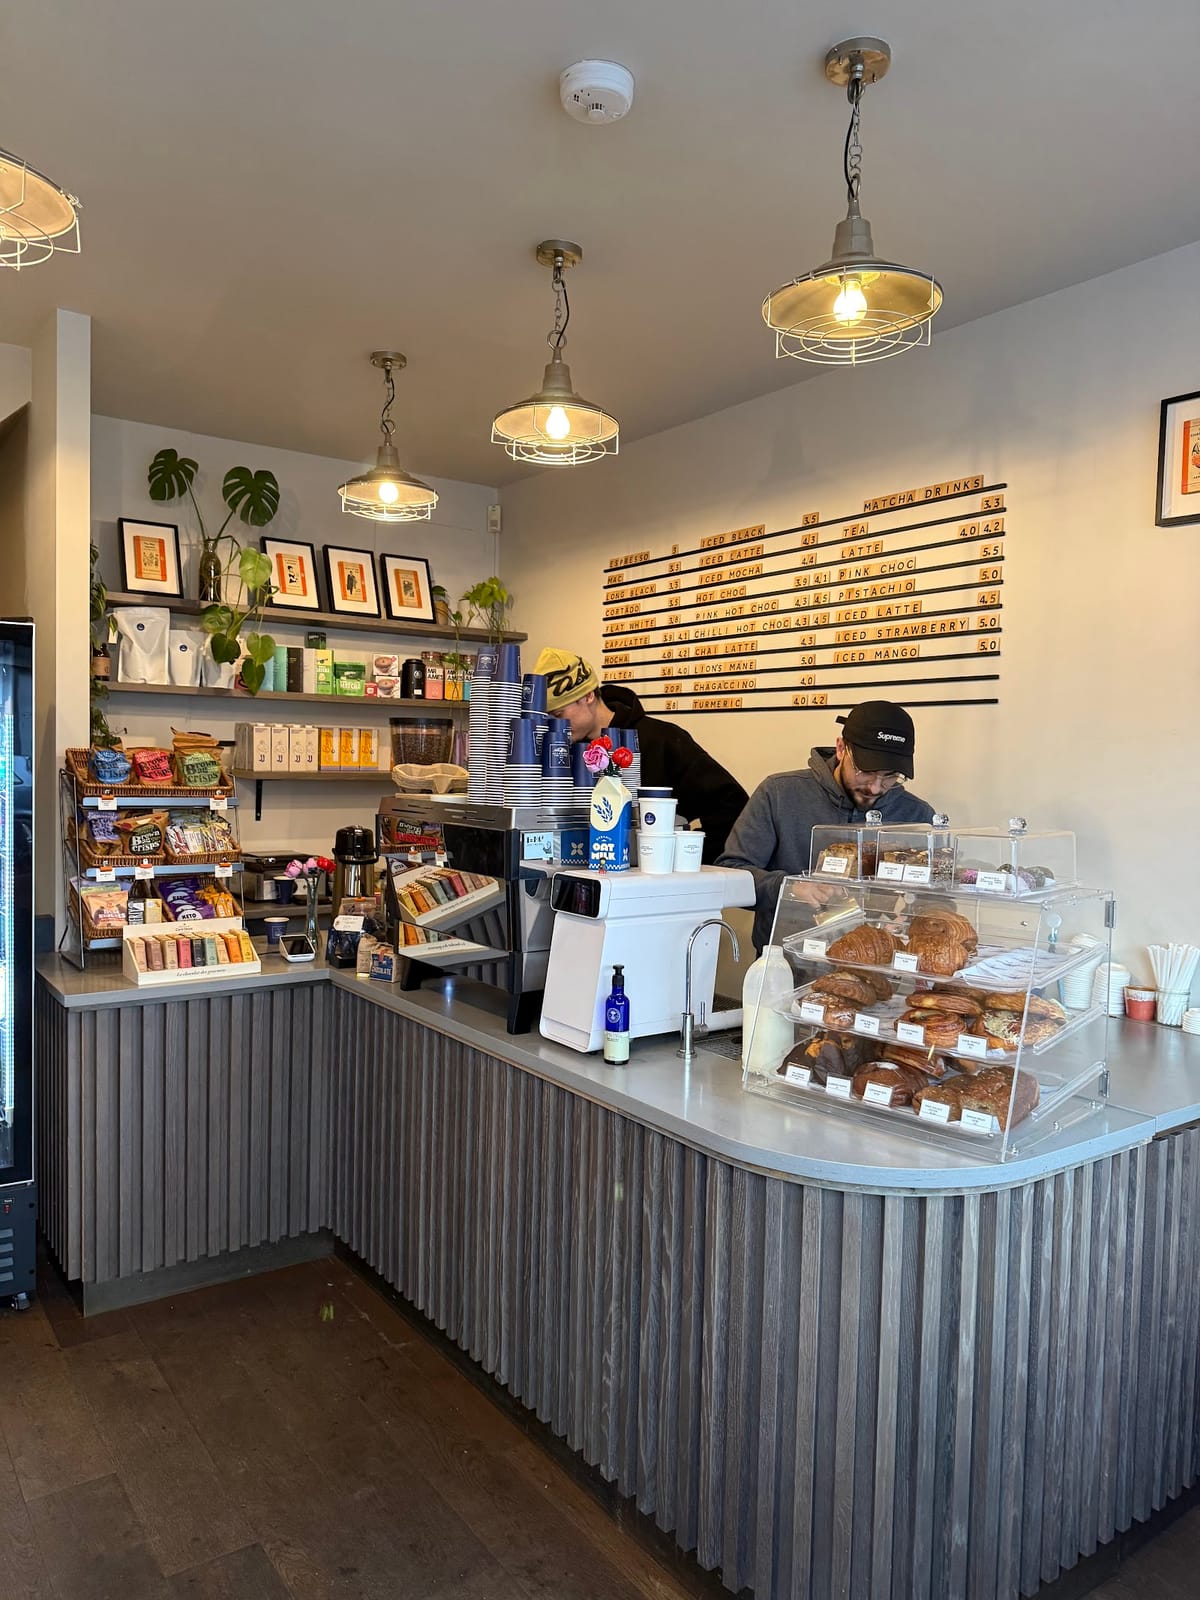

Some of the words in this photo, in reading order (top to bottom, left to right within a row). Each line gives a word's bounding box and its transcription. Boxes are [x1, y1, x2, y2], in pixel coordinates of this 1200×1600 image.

[863, 493, 914, 512] MATCHA
[924, 478, 980, 500] DRINKS
[842, 526, 866, 538] TEA
[984, 497, 1000, 509] 3.3
[702, 536, 724, 548] ICED
[732, 527, 763, 542] BLACK
[802, 514, 816, 524] 3.5
[840, 543, 880, 558] LATTE
[960, 526, 976, 537] 4.0
[983, 522, 1000, 533] 4.2
[700, 555, 723, 566] ICED
[730, 546, 761, 560] LATTE
[802, 536, 816, 545] 4.3
[608, 552, 650, 568] ESPRESSO
[839, 566, 870, 580] PINK
[880, 559, 914, 574] CHOC
[982, 546, 1000, 556] 5.5
[700, 574, 722, 584] ICED
[728, 566, 760, 578] MOCHA
[801, 556, 814, 566] 4.4
[606, 576, 622, 585] MAC
[696, 593, 713, 602] HOT
[720, 588, 745, 598] CHOC
[795, 578, 808, 586] 3.9
[814, 574, 828, 584] 4.1
[838, 582, 913, 601] PISTACHIO
[982, 569, 998, 580] 5.0
[606, 590, 625, 601] LONG
[630, 584, 656, 598] BLACK
[604, 605, 640, 616] CORTADO
[696, 610, 718, 620] PINK
[725, 606, 744, 616] HOT
[750, 601, 777, 612] CHOC
[794, 597, 808, 607] 4.3
[814, 594, 828, 604] 4.5
[837, 610, 868, 621] ICED
[877, 603, 919, 616] LATTE
[979, 593, 996, 604] 4.5
[605, 624, 624, 633] FLAT
[628, 619, 655, 630] WHITE
[694, 626, 729, 638] CHILLI
[736, 623, 756, 633] HOT
[762, 620, 789, 631] CHOC
[836, 631, 867, 642] ICED
[876, 620, 966, 638] STRAWBERRY
[979, 618, 996, 628] 5.0
[604, 637, 648, 648] CAP/LATTE
[694, 647, 718, 656] CHAI
[725, 642, 756, 654] LATTE
[836, 652, 866, 663] ICED
[874, 647, 918, 660] MANGO
[979, 640, 997, 651] 5.0
[604, 656, 628, 664] MOCHA
[694, 664, 722, 674] LION'S
[729, 662, 754, 671] MANE
[800, 656, 813, 665] 5.0
[604, 672, 632, 680] FILTER
[693, 680, 755, 692] CHAGACCINO
[800, 676, 813, 685] 4.0
[692, 700, 741, 709] TURMERIC
[877, 731, 906, 742] Supreme
[185, 760, 217, 775] Brown
[187, 772, 218, 784] crisps
[131, 830, 160, 846] Brown
[131, 840, 160, 852] crisps
[592, 842, 615, 852] OAT
[590, 852, 616, 861] MILK
